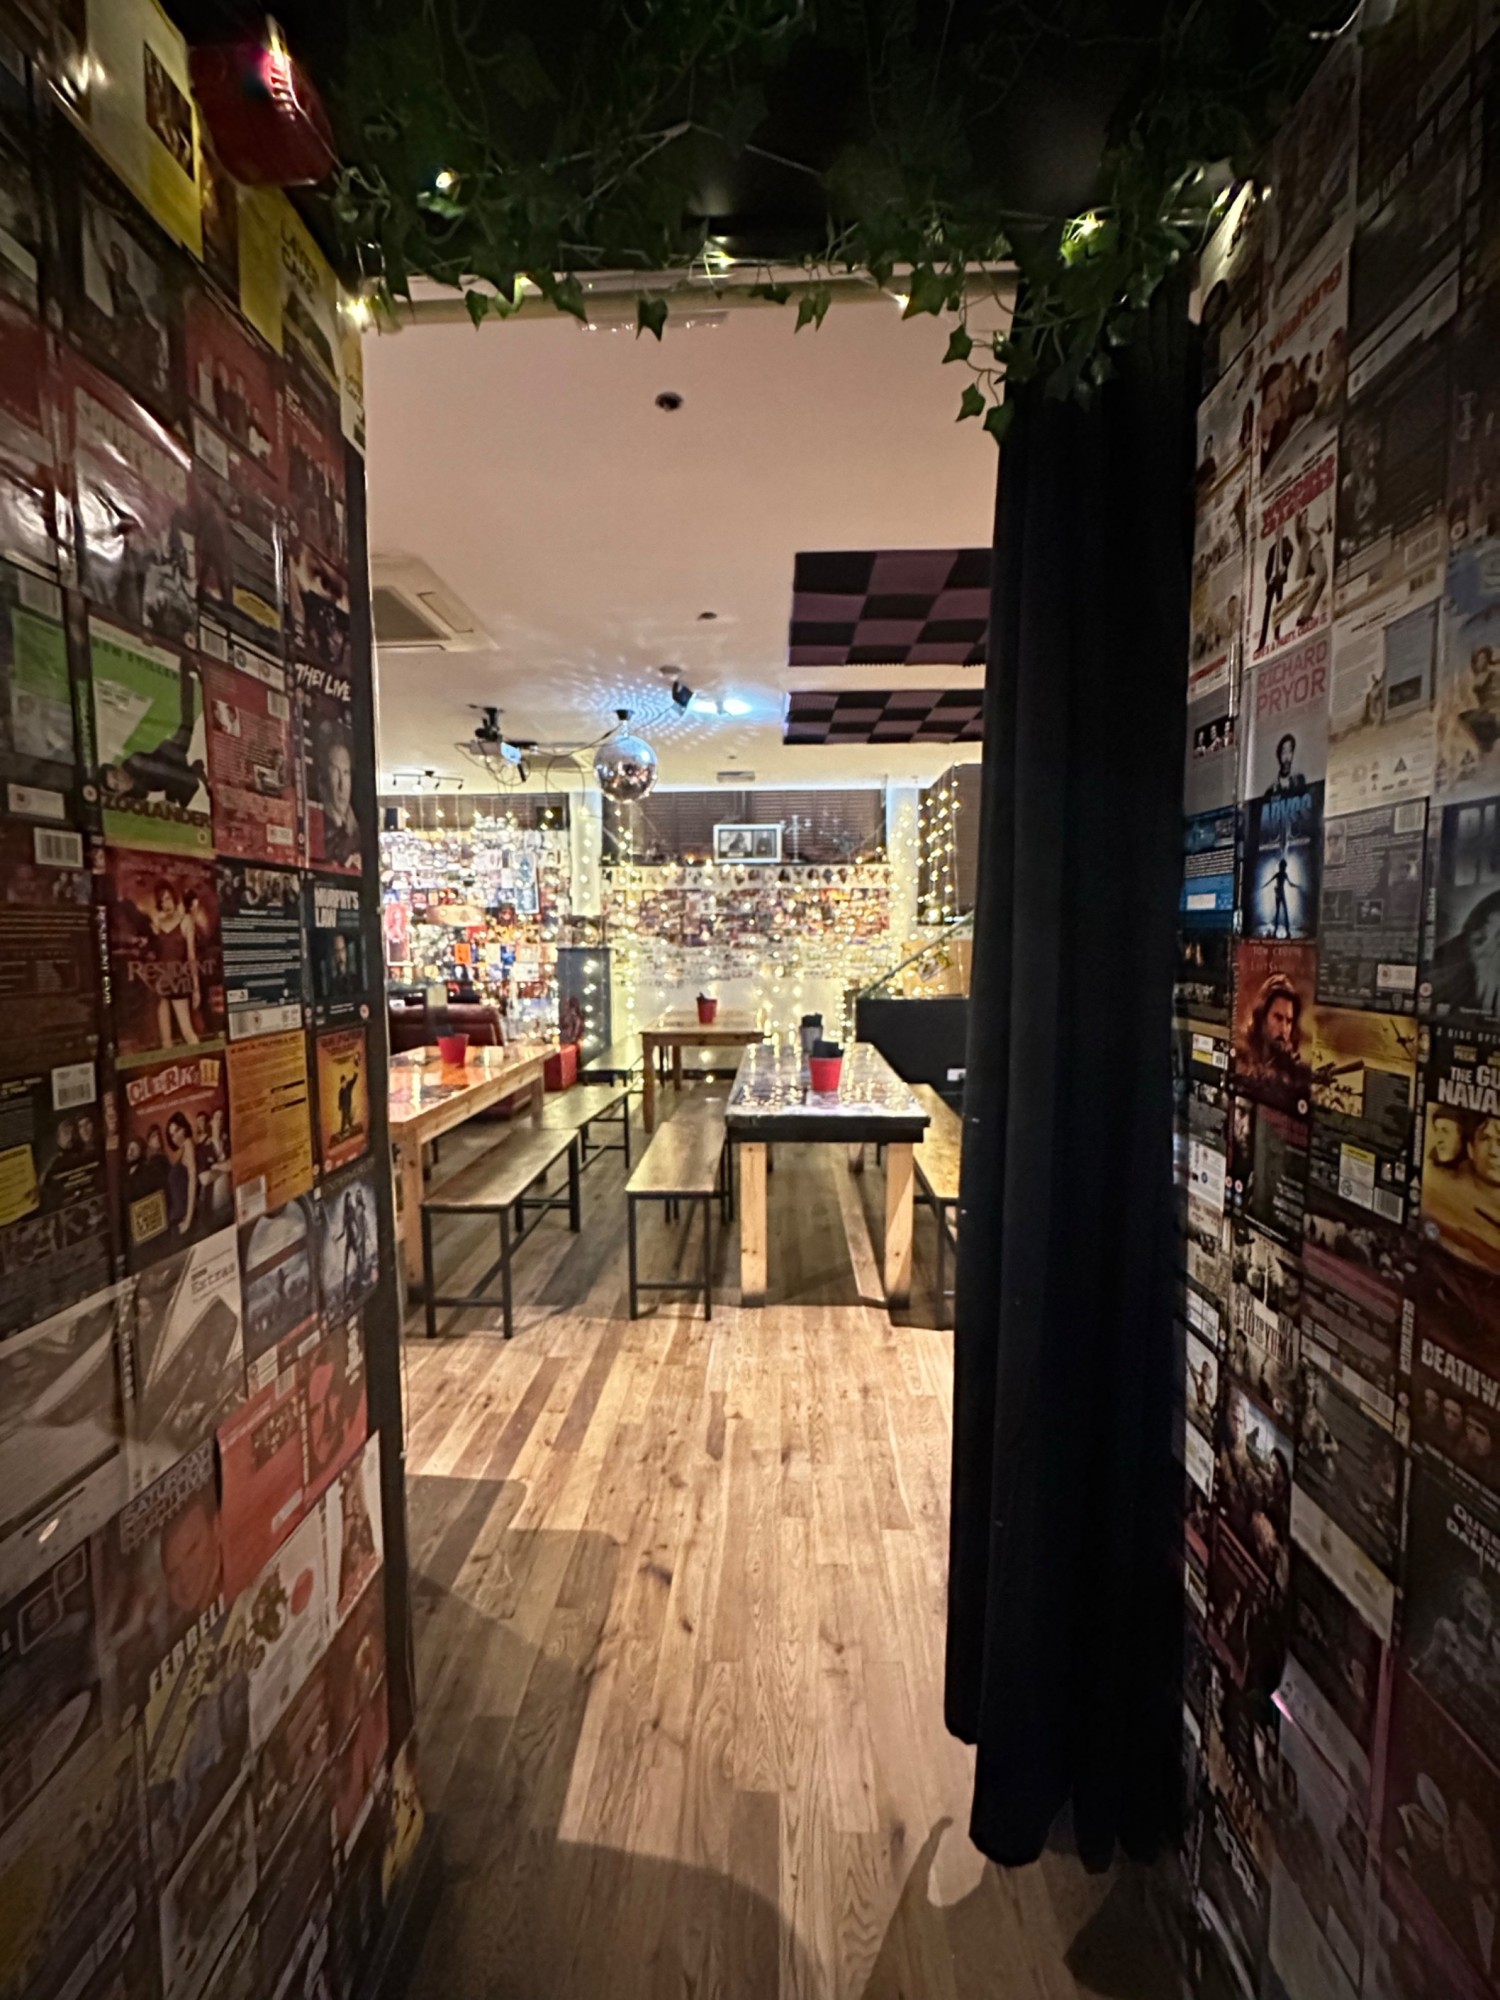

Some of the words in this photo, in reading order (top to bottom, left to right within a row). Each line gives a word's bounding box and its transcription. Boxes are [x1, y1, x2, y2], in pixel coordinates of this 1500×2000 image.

[324, 674, 351, 702] LIVE
[1259, 640, 1327, 690] RICHARD
[1257, 667, 1326, 721] PRYOR
[315, 907, 337, 928] LAW
[1450, 1065, 1474, 1084] THE
[1421, 1337, 1500, 1413] DEATHW
[1445, 1515, 1500, 1576] DAMN
